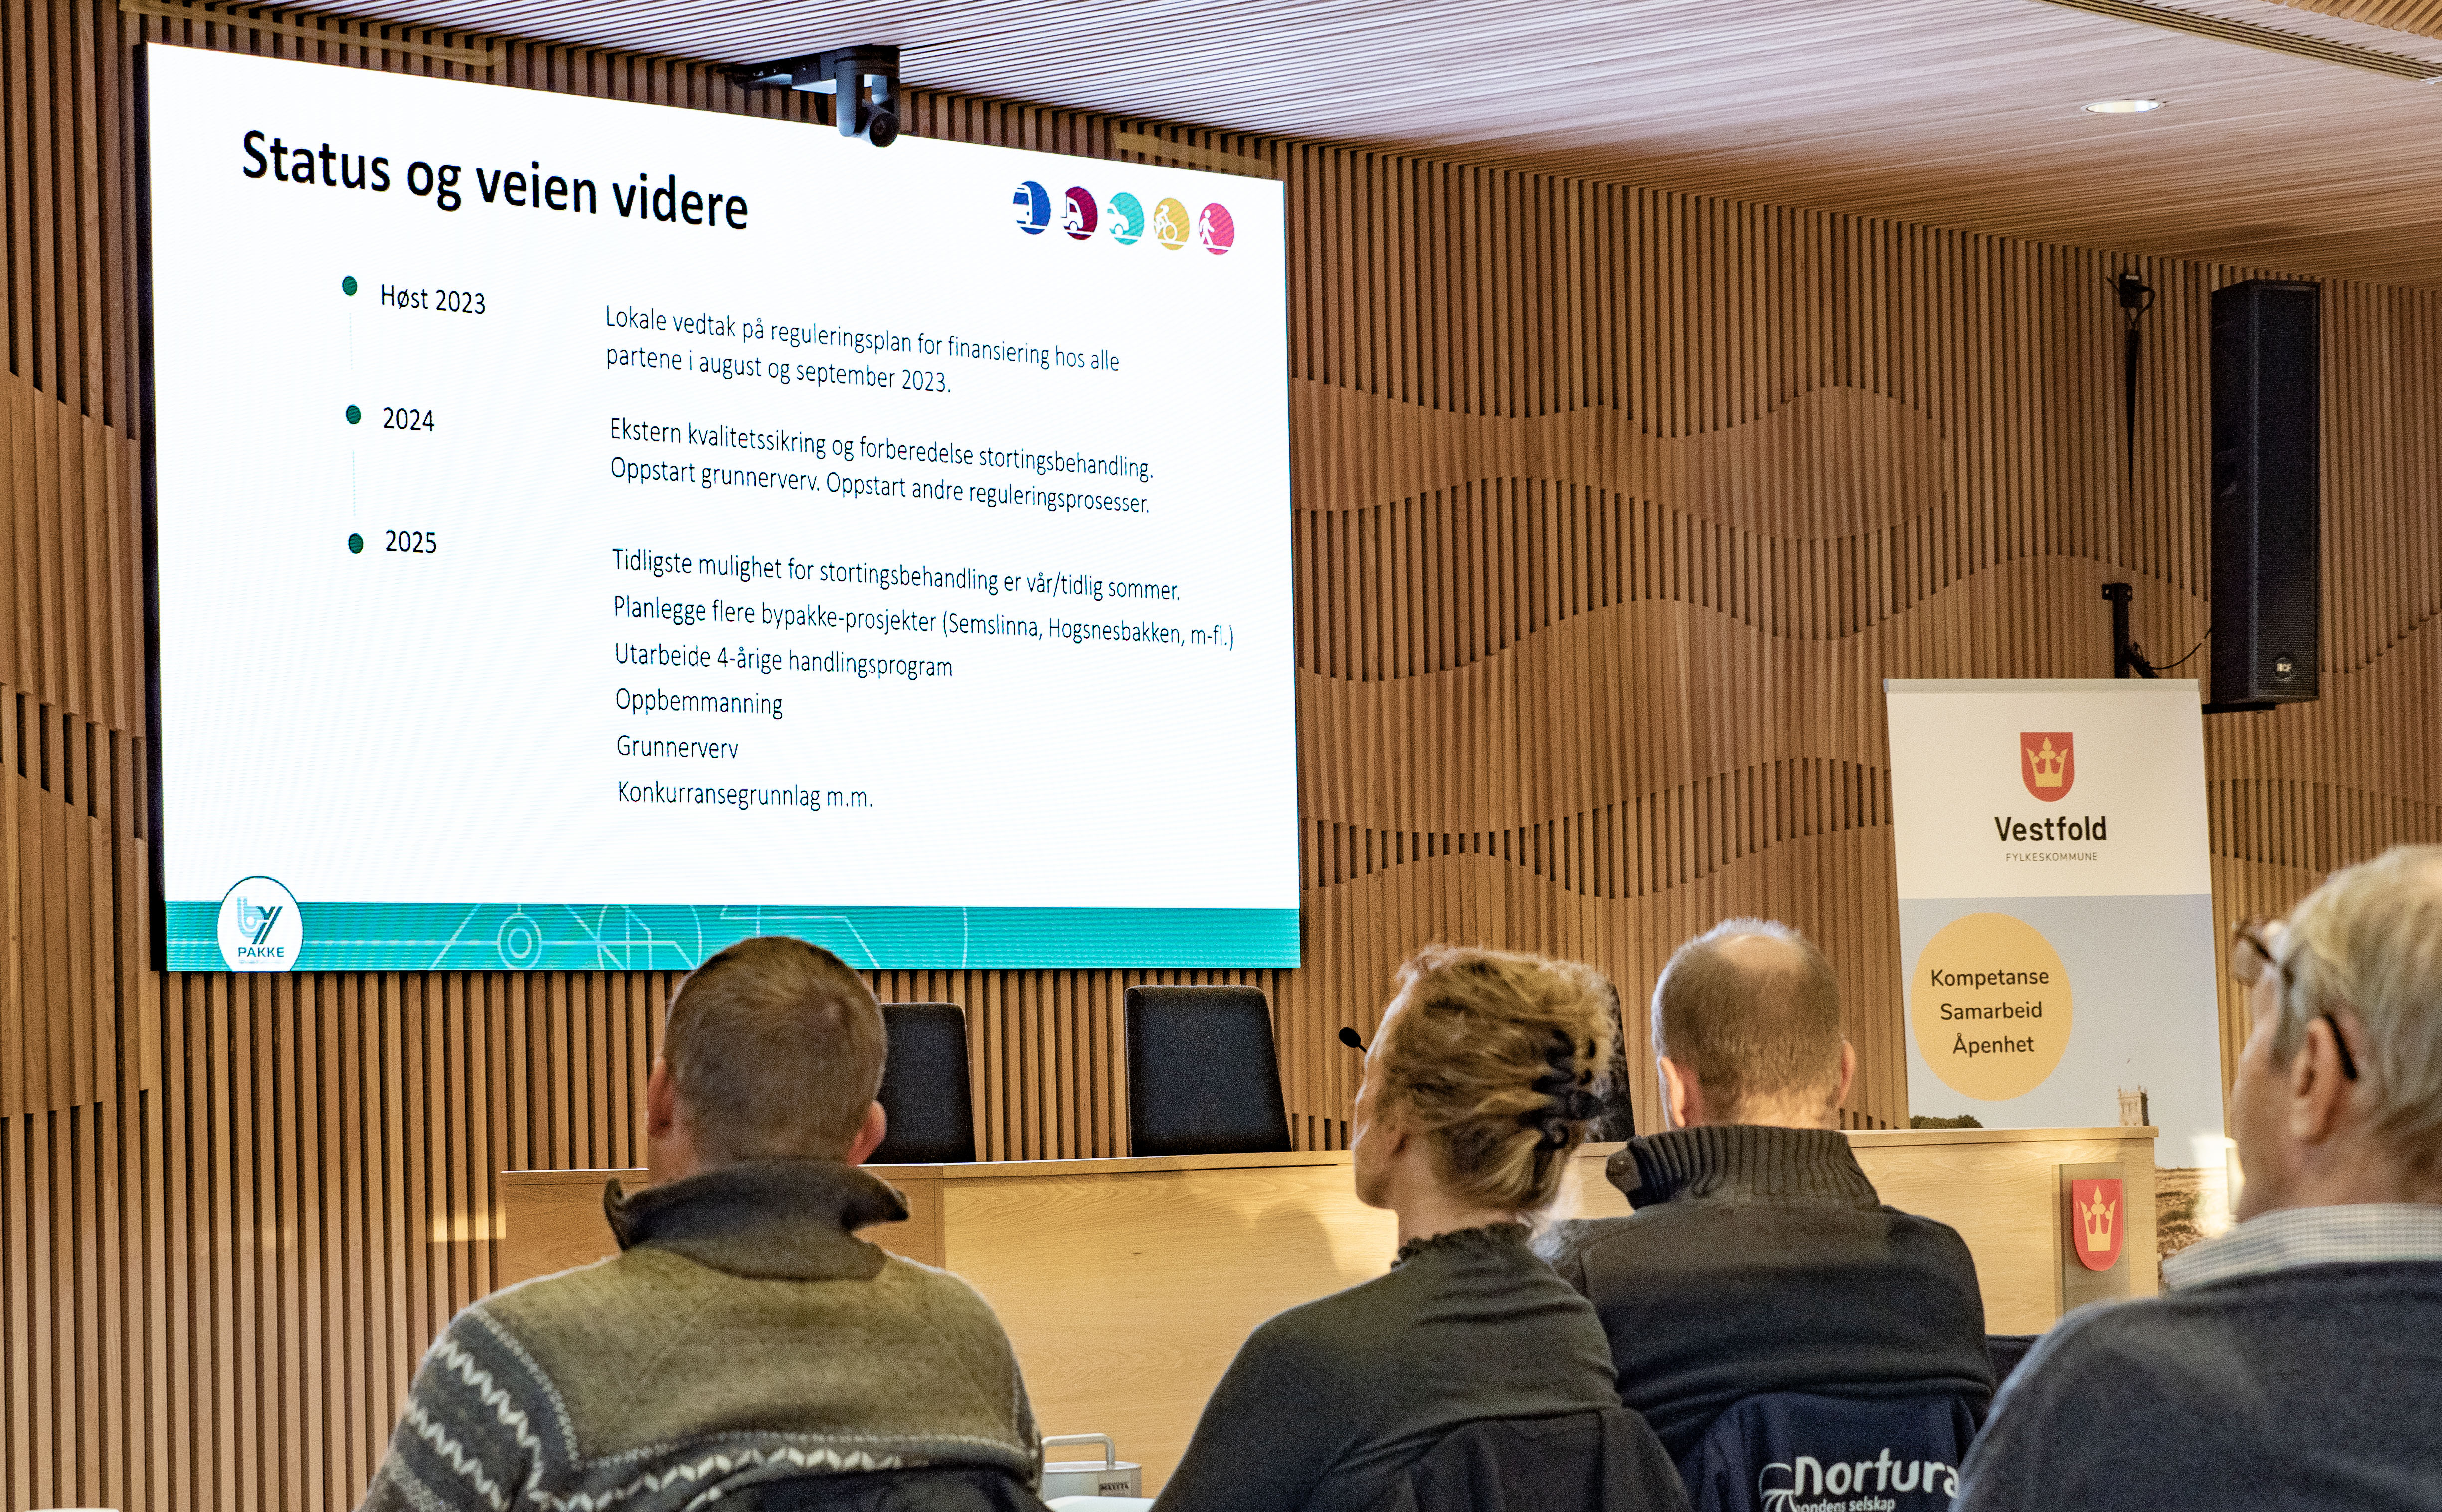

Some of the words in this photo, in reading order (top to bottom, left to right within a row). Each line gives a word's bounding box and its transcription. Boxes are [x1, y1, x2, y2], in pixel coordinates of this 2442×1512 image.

[243, 130, 390, 192] Status
[407, 161, 461, 212] og
[475, 161, 597, 214] veien
[612, 172, 748, 230] videre
[381, 284, 428, 310] Høst
[436, 289, 485, 314] 2023
[607, 305, 666, 331] Lokale
[673, 312, 736, 337] vedtak
[743, 318, 763, 343] på
[772, 323, 911, 354] reguleringsplan
[918, 333, 943, 355] for
[948, 336, 1049, 370] finansiering
[1056, 345, 1085, 368] hos
[1091, 349, 1119, 371] alle
[607, 347, 682, 370] partene
[689, 350, 692, 371] i
[699, 356, 762, 380] august
[768, 362, 790, 384] og
[796, 364, 895, 388] september
[902, 369, 951, 393] 2023.
[383, 407, 435, 432] 2024
[611, 417, 681, 443] Ekstern
[689, 422, 826, 459] kvalitetssikring
[832, 440, 854, 462] og
[860, 435, 973, 465] forberedelse
[979, 447, 1153, 483] stortingsbehandling.
[611, 456, 695, 485] Oppstart
[702, 468, 820, 491] grunnerverv.
[827, 472, 906, 499] Oppstart
[912, 478, 963, 501] andre
[970, 483, 1149, 513] reguleringsprosesser.
[386, 529, 436, 554] 2025
[612, 548, 692, 578] Tidligste
[699, 554, 782, 583] mulighet
[788, 557, 814, 580] for
[820, 562, 998, 596] stortingsbehandling
[1004, 575, 1021, 591] er
[1027, 571, 1103, 602] vår/tidlig
[1109, 581, 1180, 600] sommer.
[615, 595, 705, 626] Planlegge
[712, 599, 755, 623] flere
[762, 602, 937, 635] bypakke-prosjekter
[943, 610, 1042, 640] (Semslinna,
[1049, 618, 1185, 647] Hogsnesbakken,
[1191, 625, 1233, 651] m-fl.)
[616, 643, 710, 667] Utarbeide
[717, 646, 782, 675] 4-årige
[789, 649, 952, 681] handlingsprogram
[616, 688, 783, 720] Oppbemmanning
[617, 735, 738, 759] Grunnerverv
[619, 780, 821, 812] Konkurransegrunnlag
[827, 791, 872, 808] m.m.
[1994, 815, 2107, 842] Vestfold
[2006, 852, 2098, 861] FYLKESKOMMUNE
[238, 947, 285, 957] PAKKE
[1930, 968, 2050, 990] Kompetanse
[1940, 1001, 2043, 1021] Samarbeid
[1952, 1032, 2035, 1058] Åpenhet
[1849, 1495, 1896, 1512] selskap
